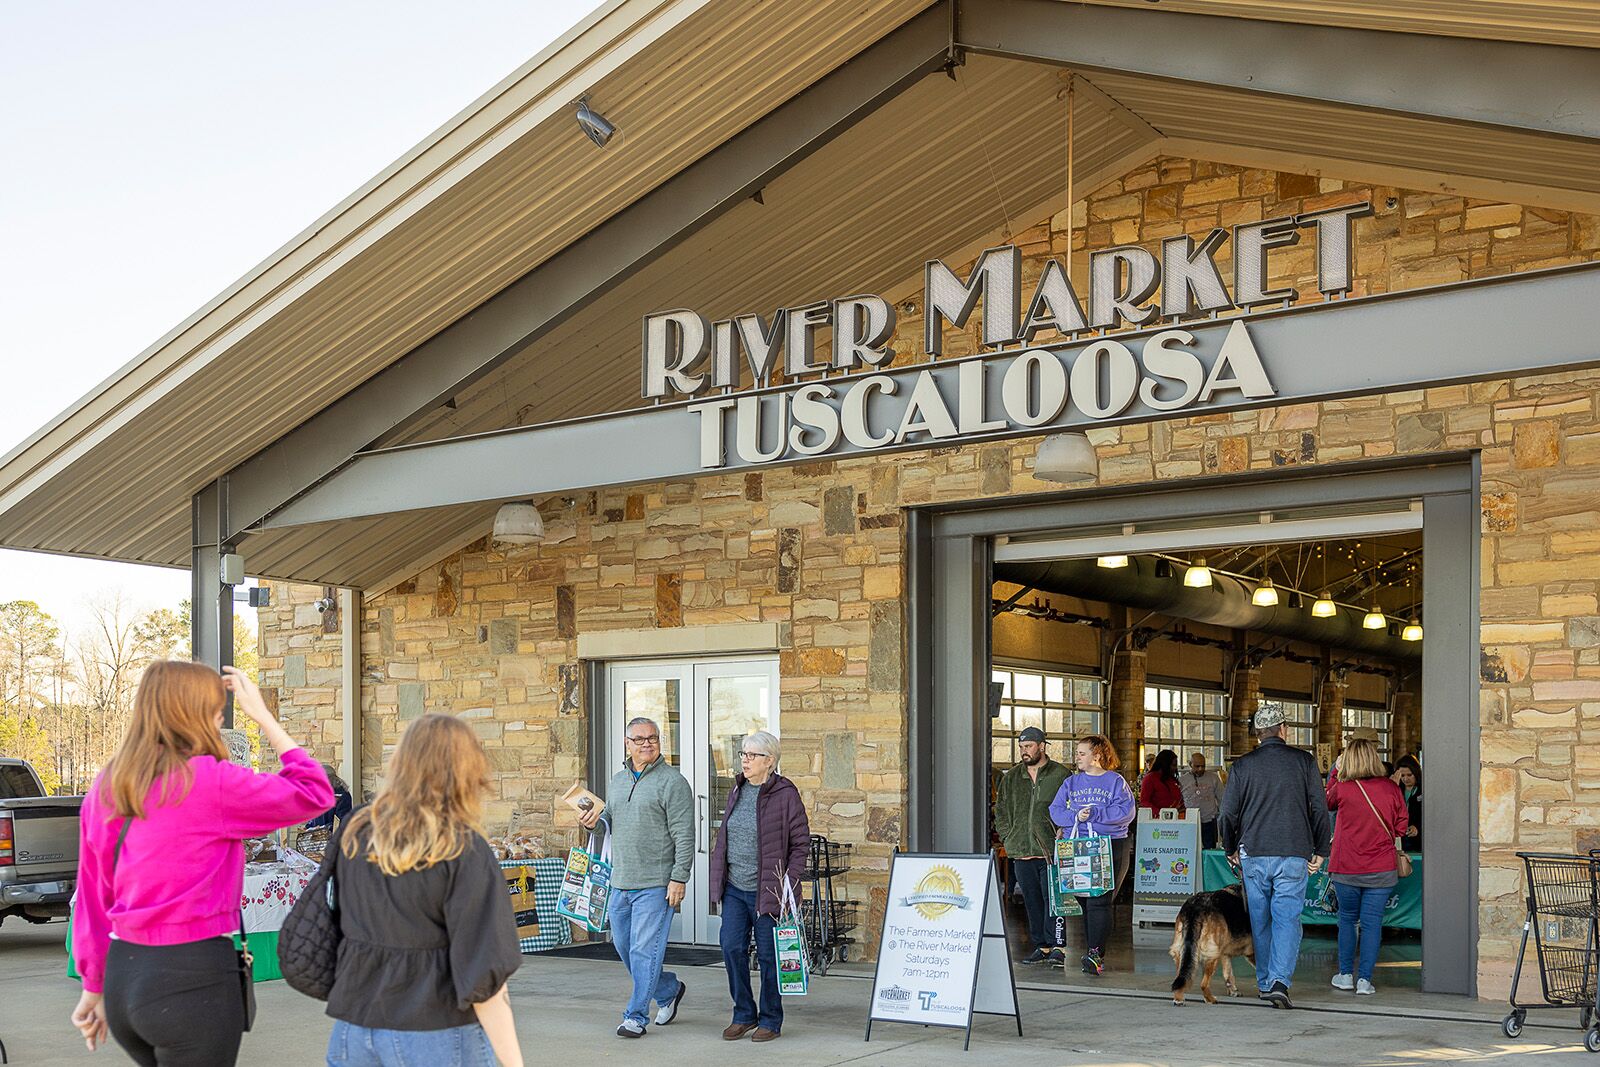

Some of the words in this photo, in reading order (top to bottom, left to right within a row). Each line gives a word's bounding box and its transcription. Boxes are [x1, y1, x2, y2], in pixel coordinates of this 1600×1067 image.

[641, 294, 896, 398] RIVER
[924, 202, 1374, 358] MARKET
[687, 320, 1277, 469] TUSCALOOSA
[1070, 788, 1092, 797] ORANGE
[1093, 788, 1113, 799] BEACH
[888, 925, 906, 936] The
[906, 927, 943, 938] Farmers
[944, 931, 976, 941] Market
[888, 940, 897, 951] @
[899, 939, 916, 950] The
[917, 940, 939, 951] River
[941, 943, 972, 954] Market
[905, 953, 950, 967] Saturdays
[902, 967, 950, 979] 7am-12pm
[931, 1004, 966, 1012] TUSCALOOSA
